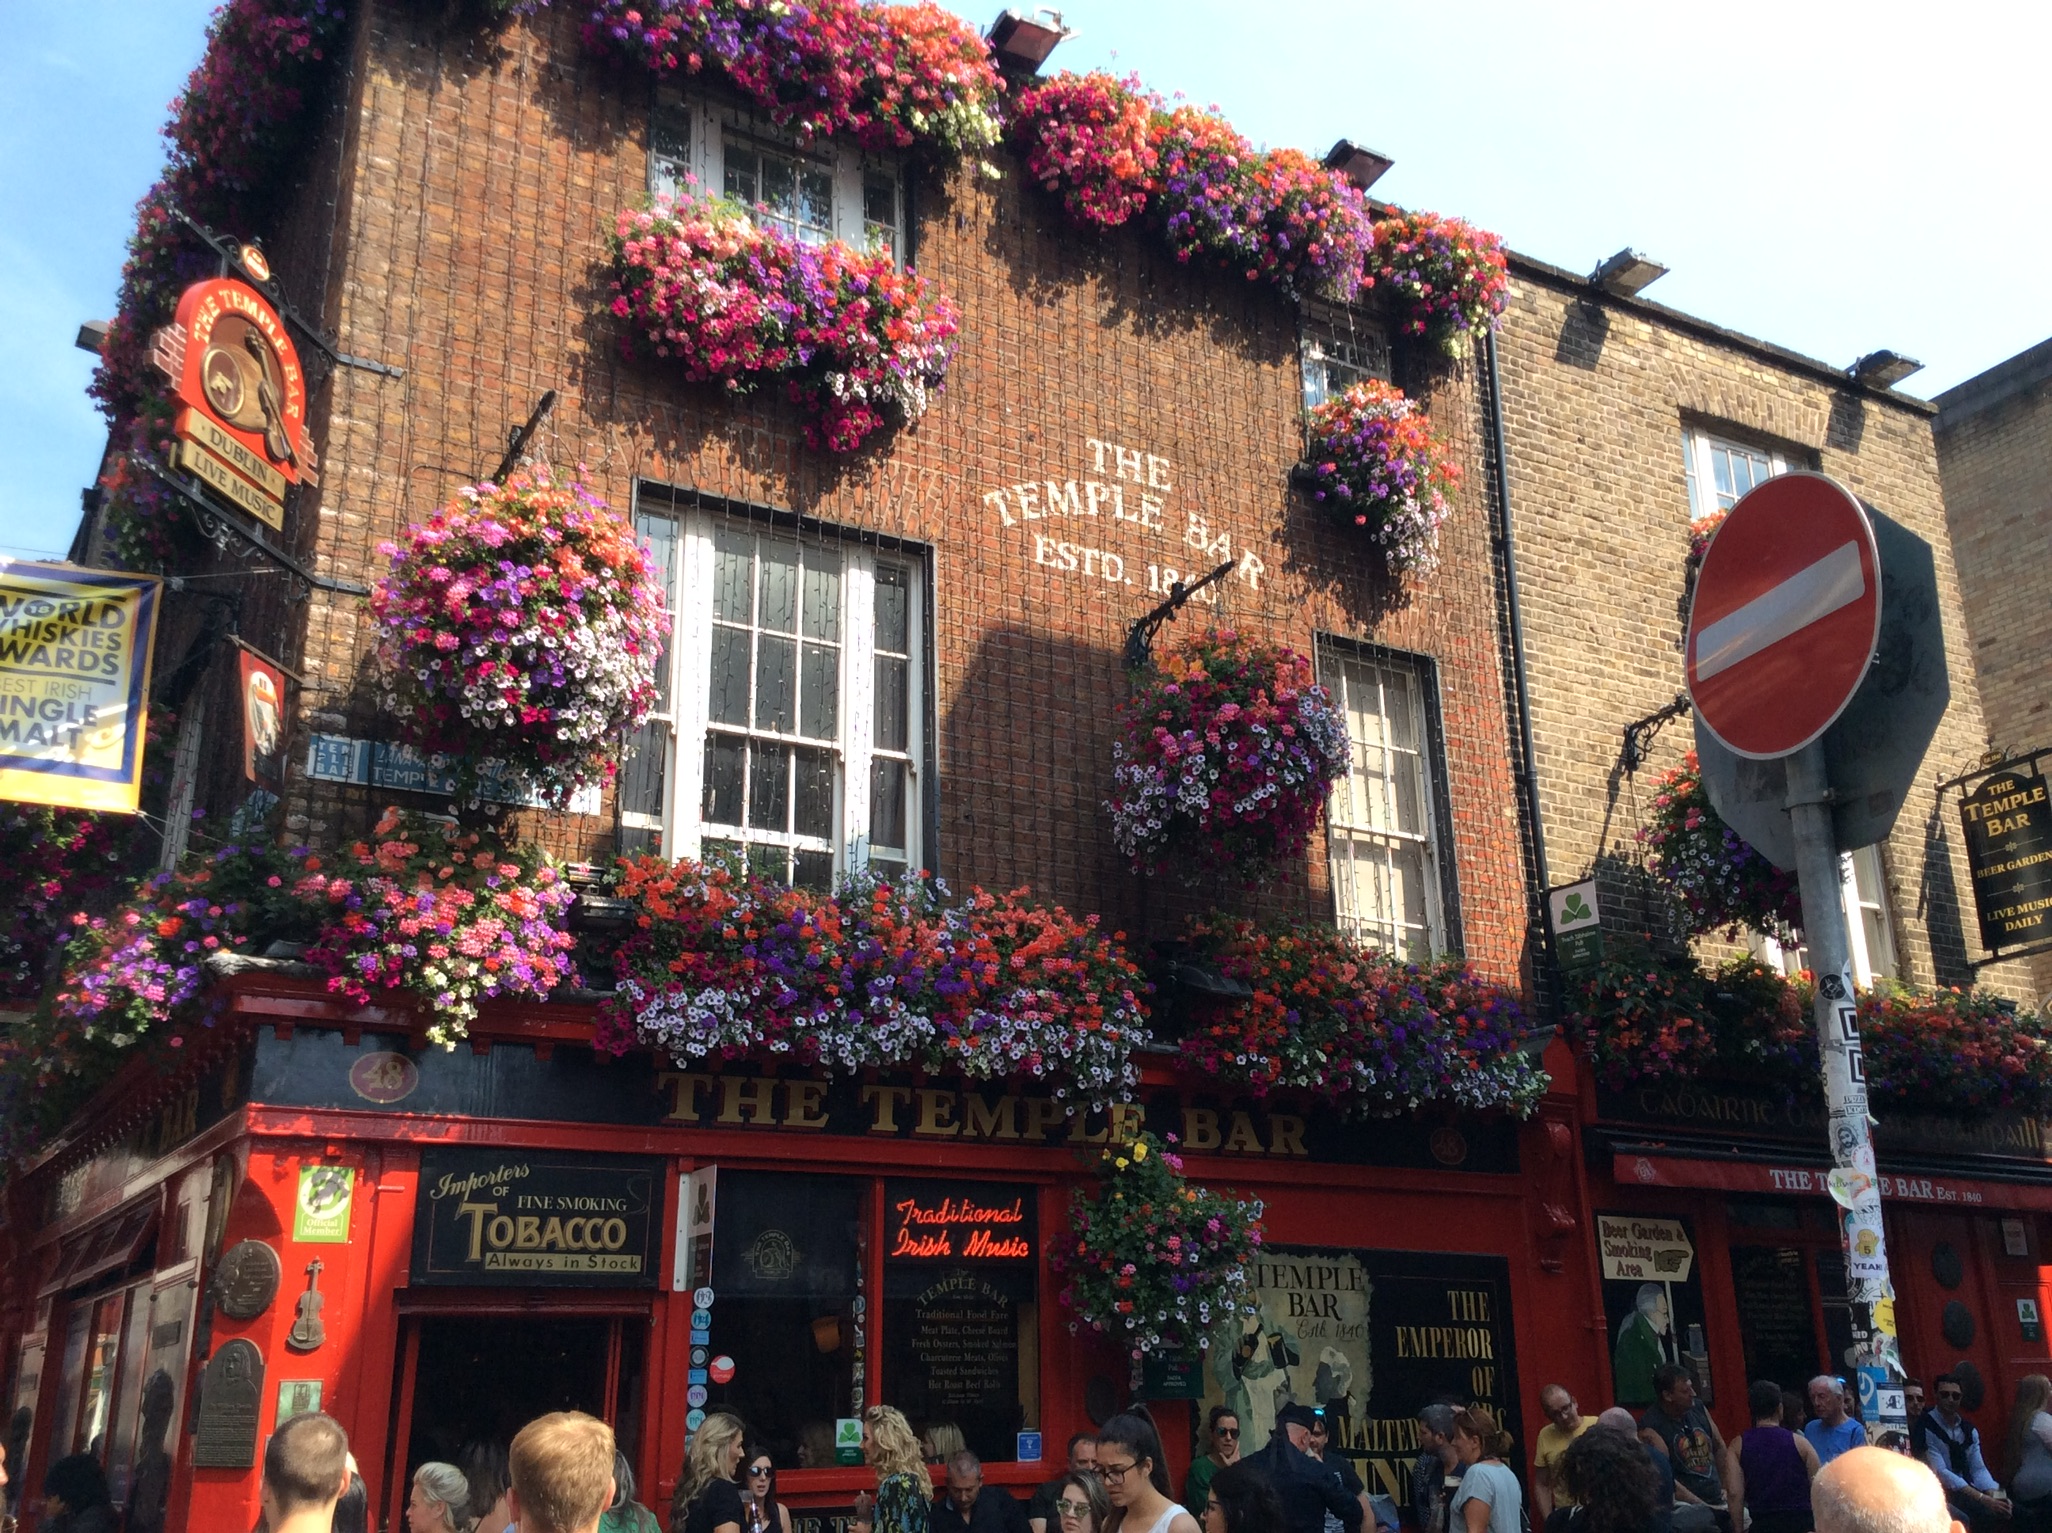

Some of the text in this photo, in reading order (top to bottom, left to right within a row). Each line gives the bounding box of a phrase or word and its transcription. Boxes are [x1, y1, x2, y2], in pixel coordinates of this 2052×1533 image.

[193, 288, 298, 419] THE TEMPLE BAR
[210, 429, 268, 483] DUBLIN
[1086, 437, 1172, 491] THE
[195, 452, 275, 521] LIVE MUSIC
[983, 479, 1265, 590] TEMPLE BAR
[1034, 533, 1132, 586] ESTD.
[0, 618, 122, 651] HISKIES
[0, 677, 92, 702] EST IRISH
[0, 719, 83, 749] MALT
[1987, 779, 2016, 796] THE
[1964, 787, 2046, 822] TEMPLE
[1986, 813, 2031, 837] BAR
[1976, 851, 2052, 880] BEER GARDEN
[1986, 906, 2014, 922] LIVE
[2005, 914, 2043, 932] DAILY
[362, 1058, 405, 1090] 48
[656, 1071, 1308, 1156] THE TEMPLE BAR
[429, 1163, 530, 1201] Importers
[492, 1186, 510, 1197] OF
[1769, 1169, 1812, 1190] THE
[1896, 1178, 1934, 1199] BAR
[1962, 1191, 1982, 1202] 1840
[517, 1195, 627, 1212] FINE SMOKING
[896, 1198, 1023, 1225] Traditional
[303, 1226, 340, 1235] Member
[306, 1218, 338, 1227] Official
[454, 1202, 628, 1263] TOBACCO
[1602, 1221, 1685, 1241] Beer Garden &
[892, 1227, 1029, 1257] Irish Music
[1604, 1240, 1652, 1262] Smoking
[1864, 1246, 1872, 1254] 5
[487, 1254, 638, 1270] Always in Stock
[1617, 1260, 1644, 1277] Area
[1255, 1263, 1365, 1292] TEMPLE
[916, 1277, 1008, 1308] TEMPLE BAR
[1288, 1292, 1343, 1321] BAR
[1447, 1290, 1490, 1322] THE
[915, 1309, 1008, 1320] Traditional Food Fare
[911, 1339, 930, 1348] Fresh
[963, 1339, 989, 1348] Smoked
[921, 1326, 938, 1334] Meat
[962, 1326, 986, 1334] Cheese
[988, 1326, 1008, 1335] Board
[1395, 1326, 1494, 1360] EMPEROR
[928, 1380, 941, 1389] Hot
[944, 1380, 963, 1389] Roast
[966, 1380, 981, 1389] Beef
[931, 1366, 999, 1375] Toasted Sandwiches
[1471, 1365, 1495, 1397] OF
[1337, 1415, 1420, 1452] MALTED
